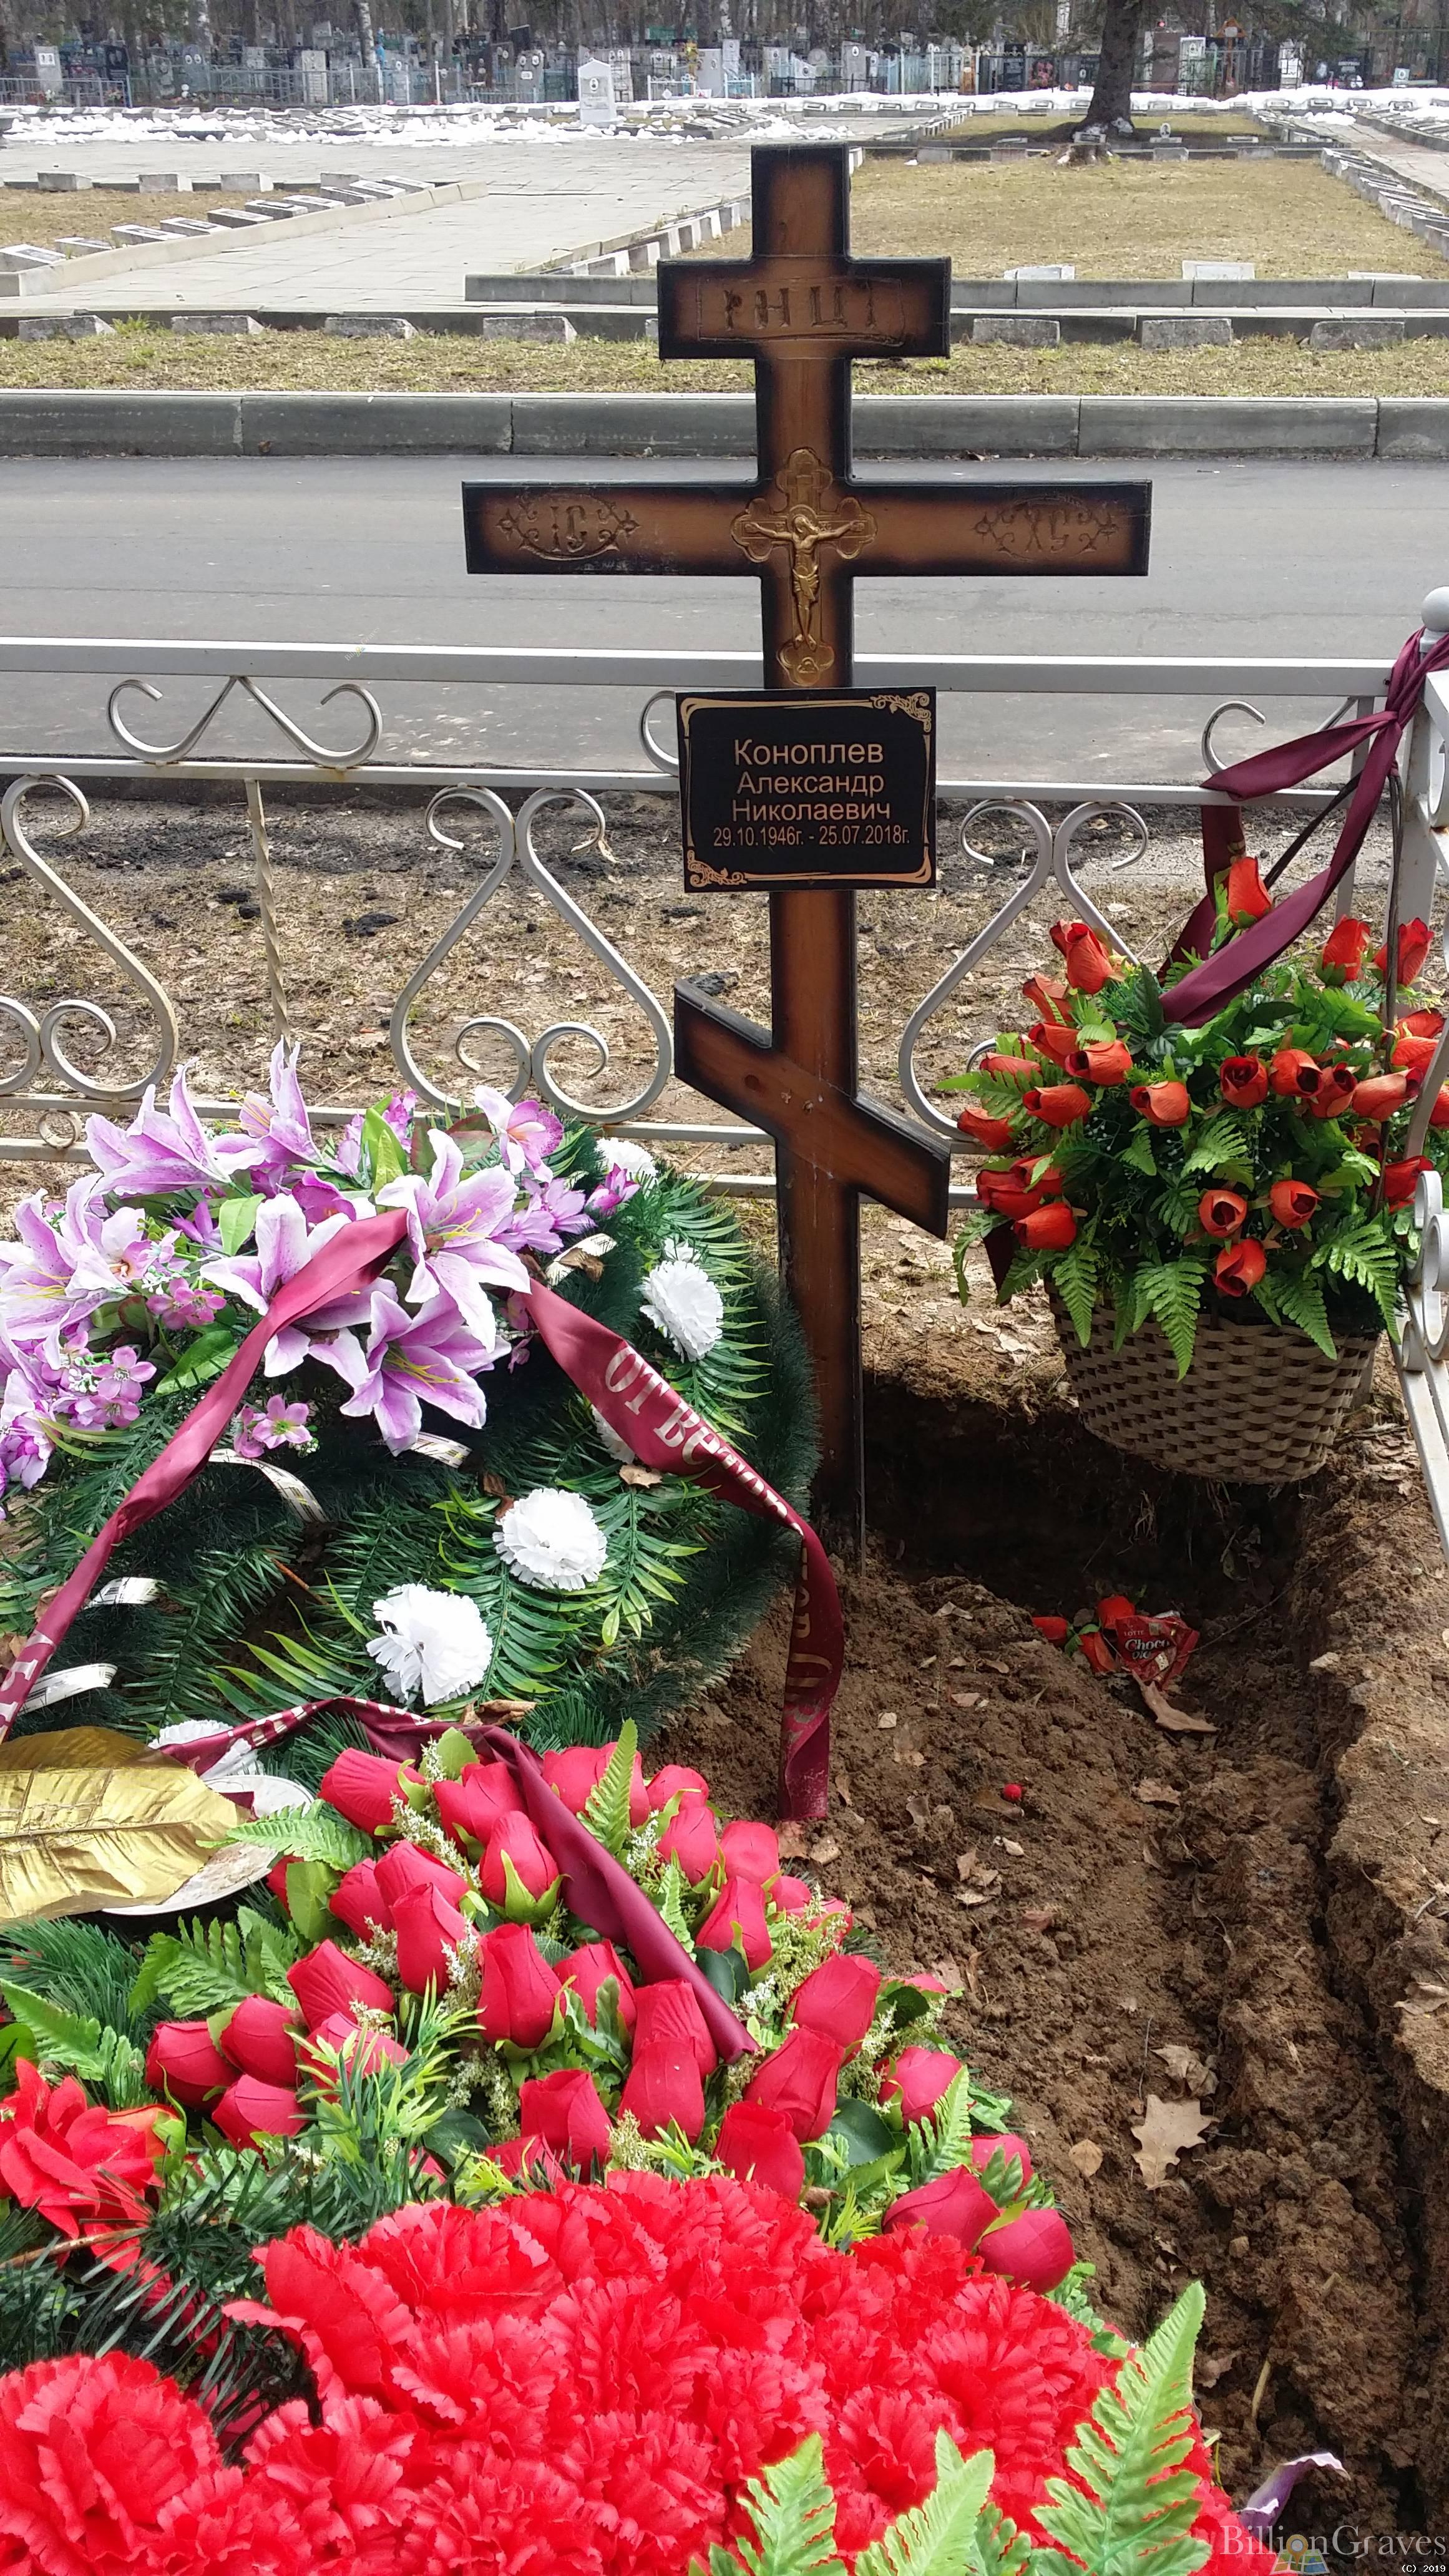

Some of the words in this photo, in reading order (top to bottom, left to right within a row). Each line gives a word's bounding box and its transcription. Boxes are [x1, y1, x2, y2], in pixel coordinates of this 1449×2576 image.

[734, 738, 884, 766] Коноплев
[736, 771, 885, 798] Александр
[731, 799, 891, 822] Николаевич
[713, 826, 804, 847] 29.10.1946г.
[818, 824, 910, 846] 25.07.2018г.
